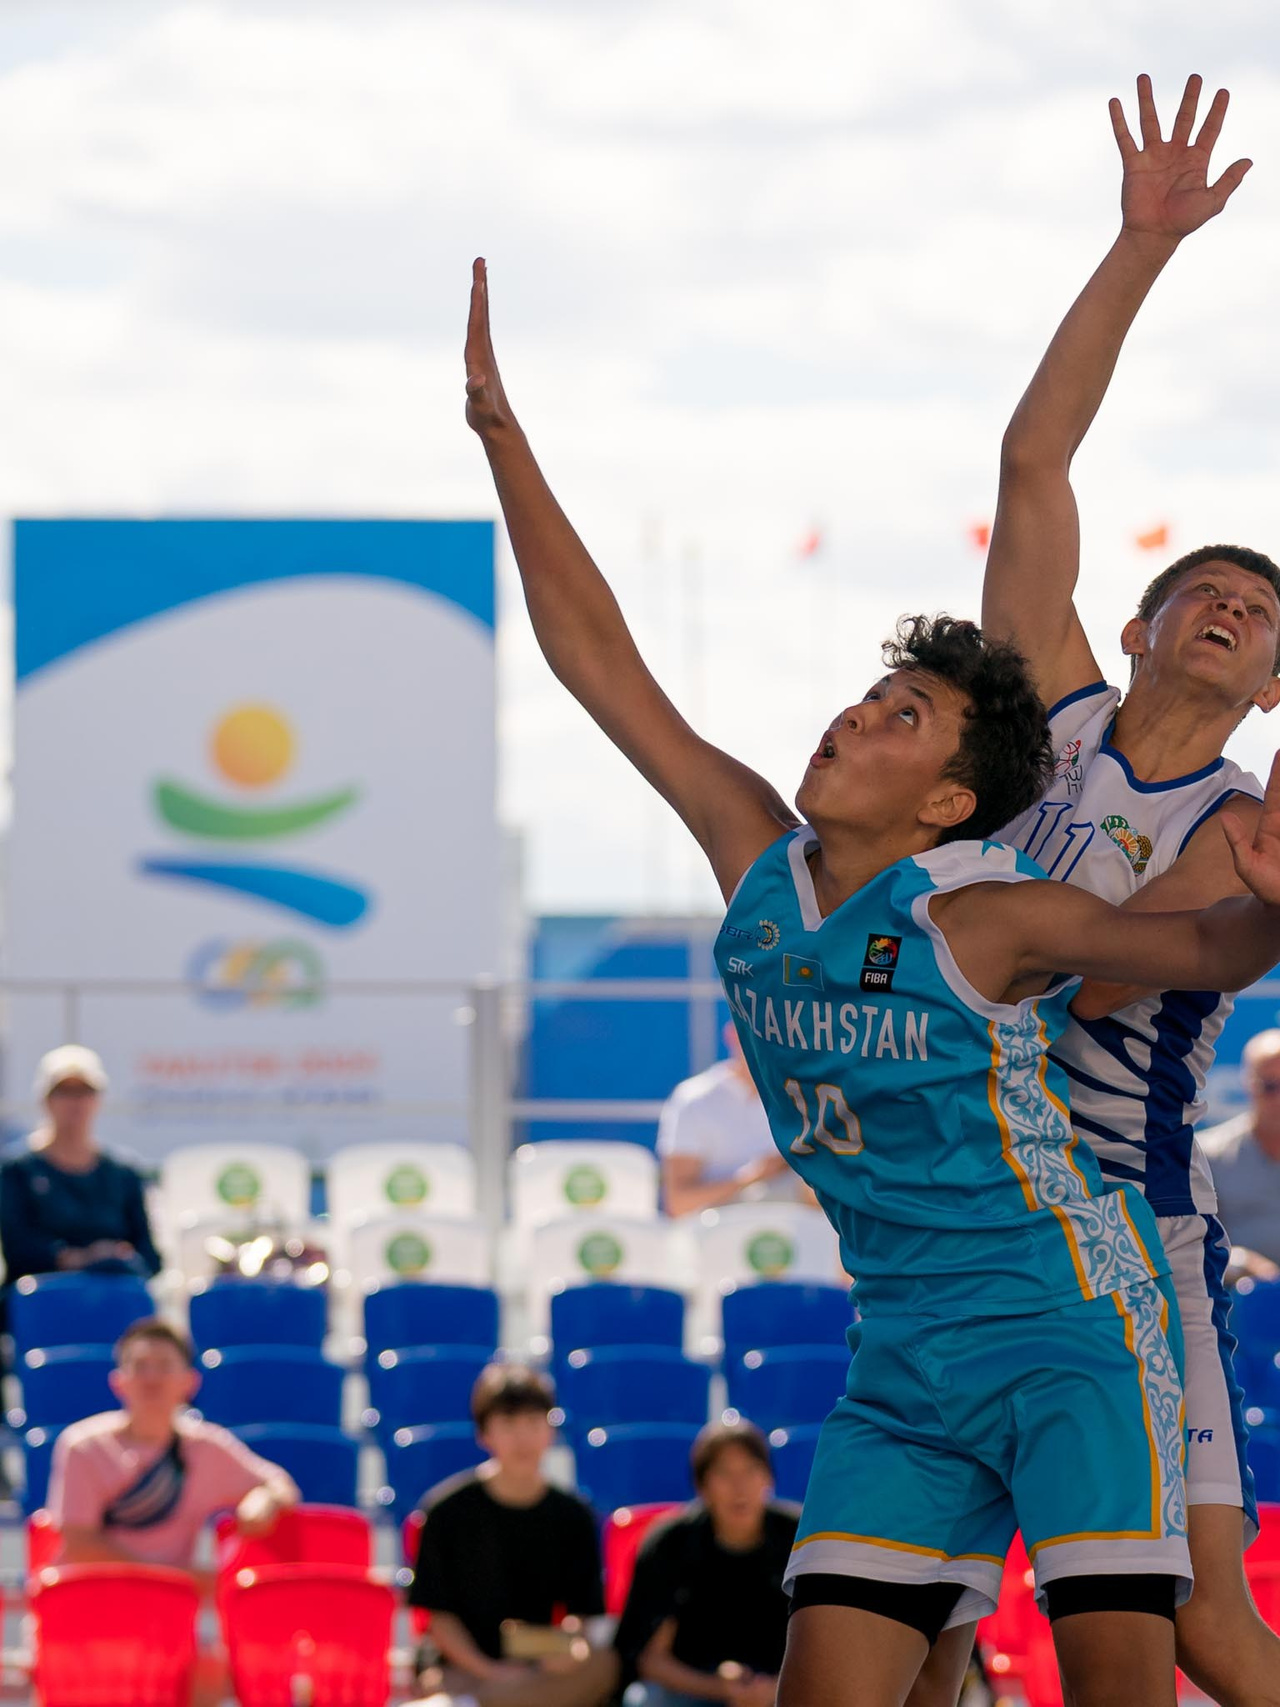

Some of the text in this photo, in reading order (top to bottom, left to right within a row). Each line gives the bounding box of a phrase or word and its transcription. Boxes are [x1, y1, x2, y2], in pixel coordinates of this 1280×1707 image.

[727, 957, 754, 977] STK
[864, 972, 888, 984] FIBA
[784, 1077, 865, 1155] 10
